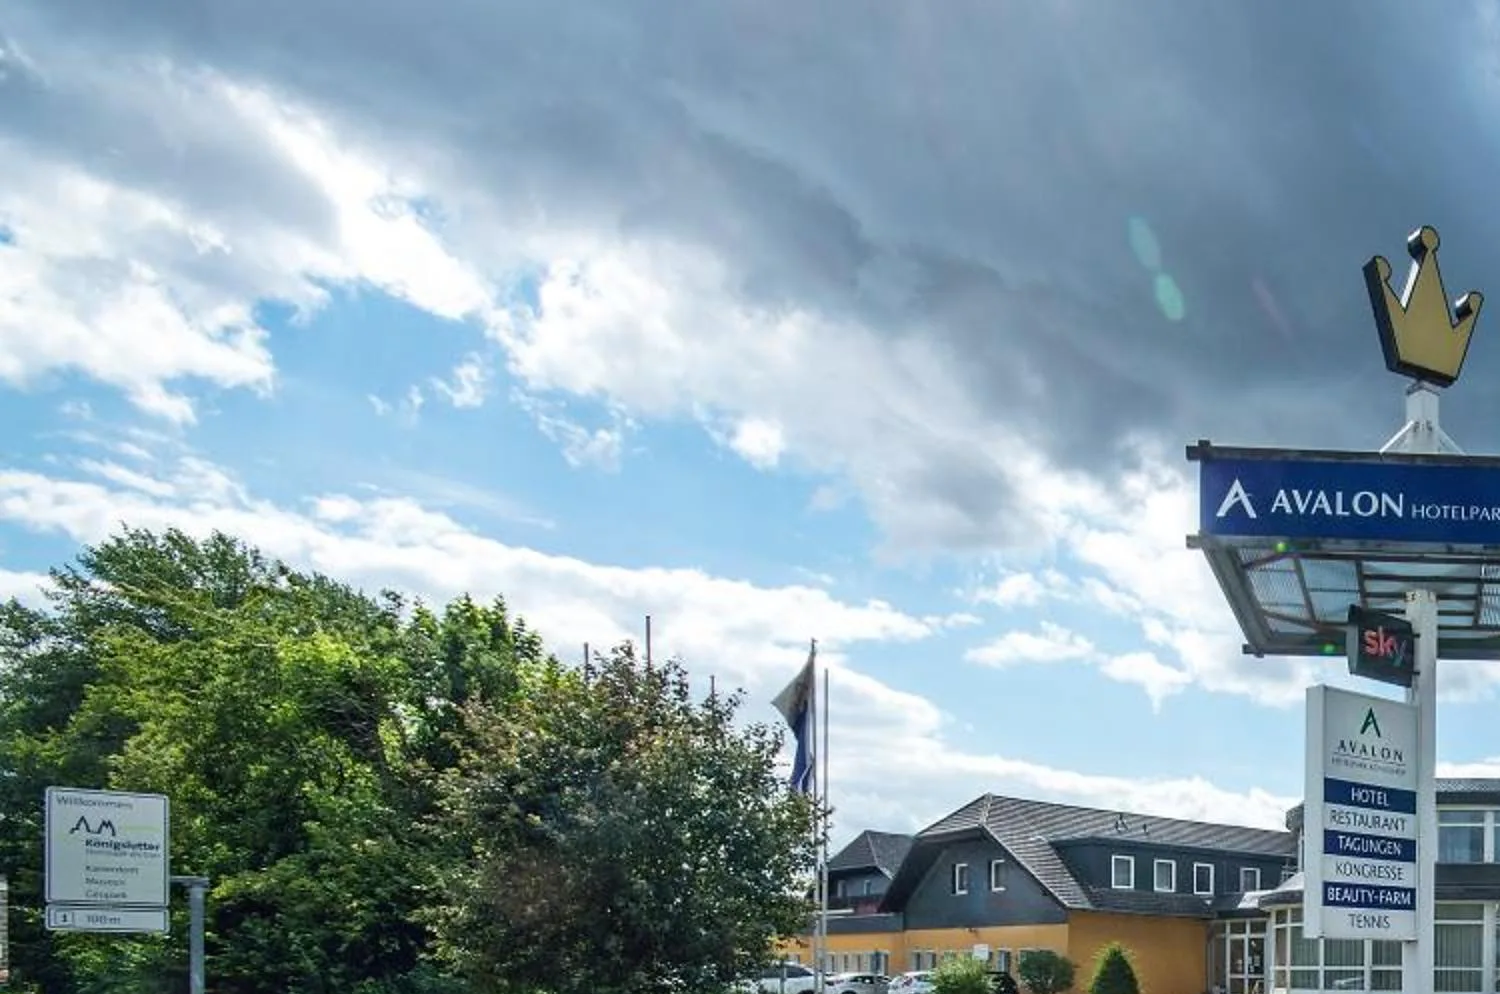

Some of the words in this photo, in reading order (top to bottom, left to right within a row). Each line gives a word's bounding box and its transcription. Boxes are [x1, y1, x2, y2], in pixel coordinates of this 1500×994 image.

[1271, 489, 1404, 518] AVALON
[1338, 739, 1404, 763] AVALON
[1351, 787, 1390, 808] HOTEL
[1330, 809, 1407, 833] RESTAURANT
[1338, 835, 1401, 856] TAGUNGEN
[1335, 862, 1405, 881] KONGRESSE
[1327, 887, 1411, 905] BEAUTY-FARM
[1349, 912, 1391, 930] TENNIS
